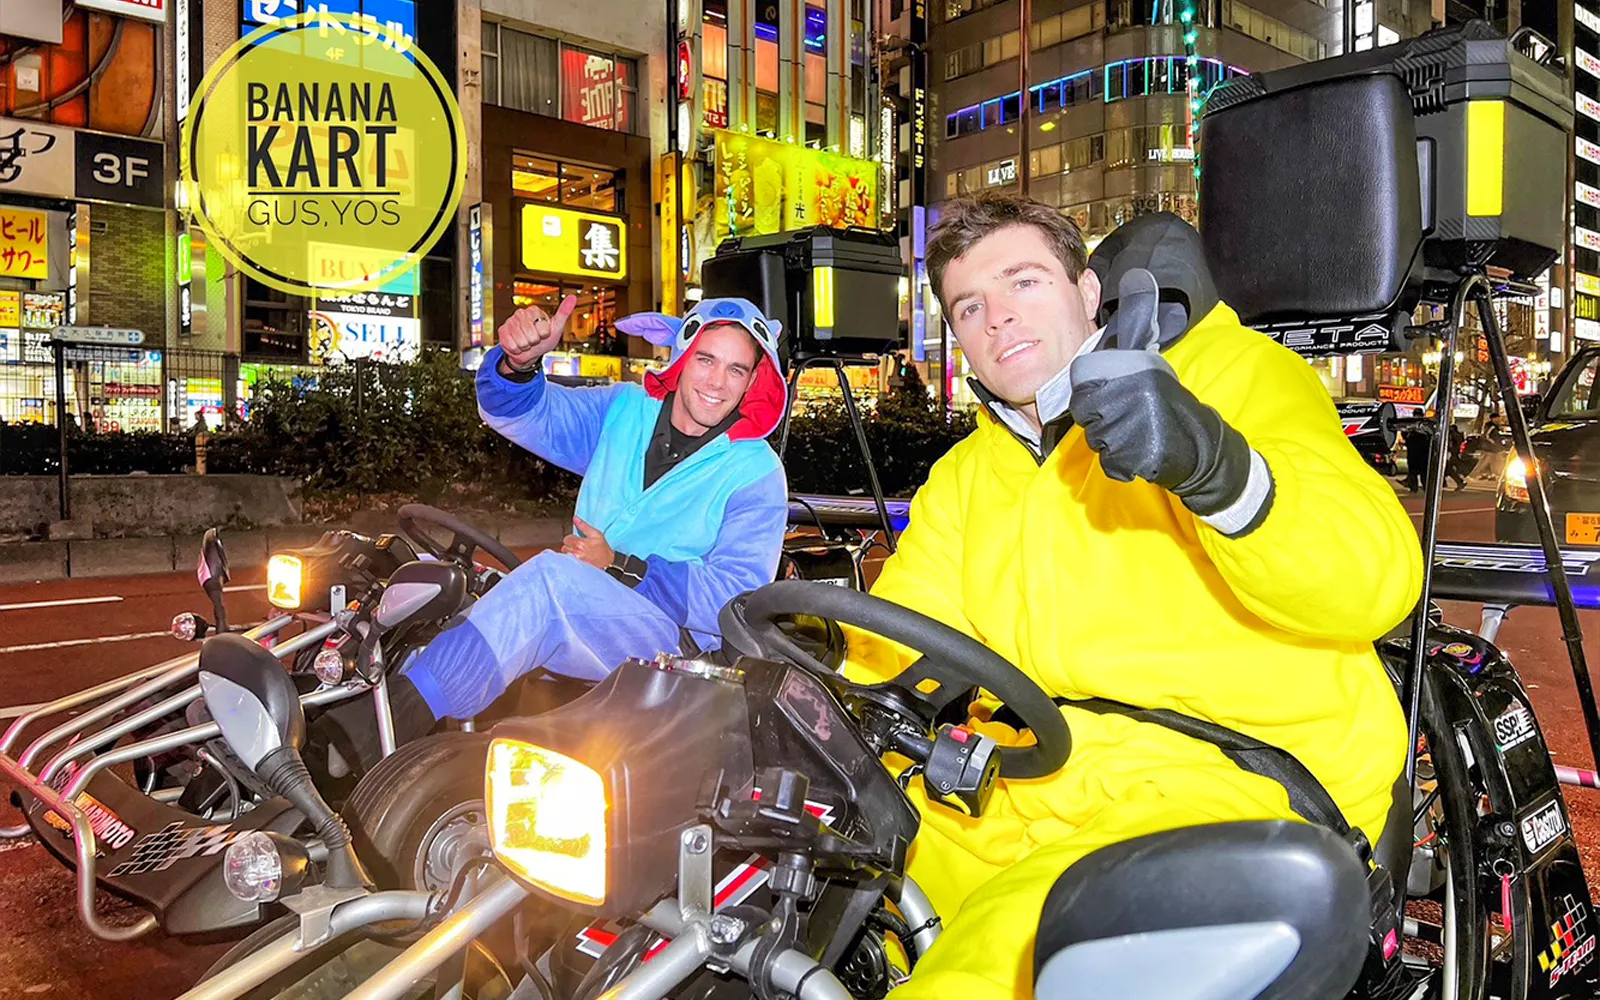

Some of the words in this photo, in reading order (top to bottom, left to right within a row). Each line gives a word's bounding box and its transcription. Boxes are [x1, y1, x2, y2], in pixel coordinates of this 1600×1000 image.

[325, 47, 345, 60] 4F
[93, 152, 149, 186] 3F
[2, 216, 44, 245] ビール
[580, 223, 620, 269] 集
[2, 247, 45, 272] サワー
[321, 258, 374, 281] BUY
[1340, 339, 1389, 348] PRODUCTS
